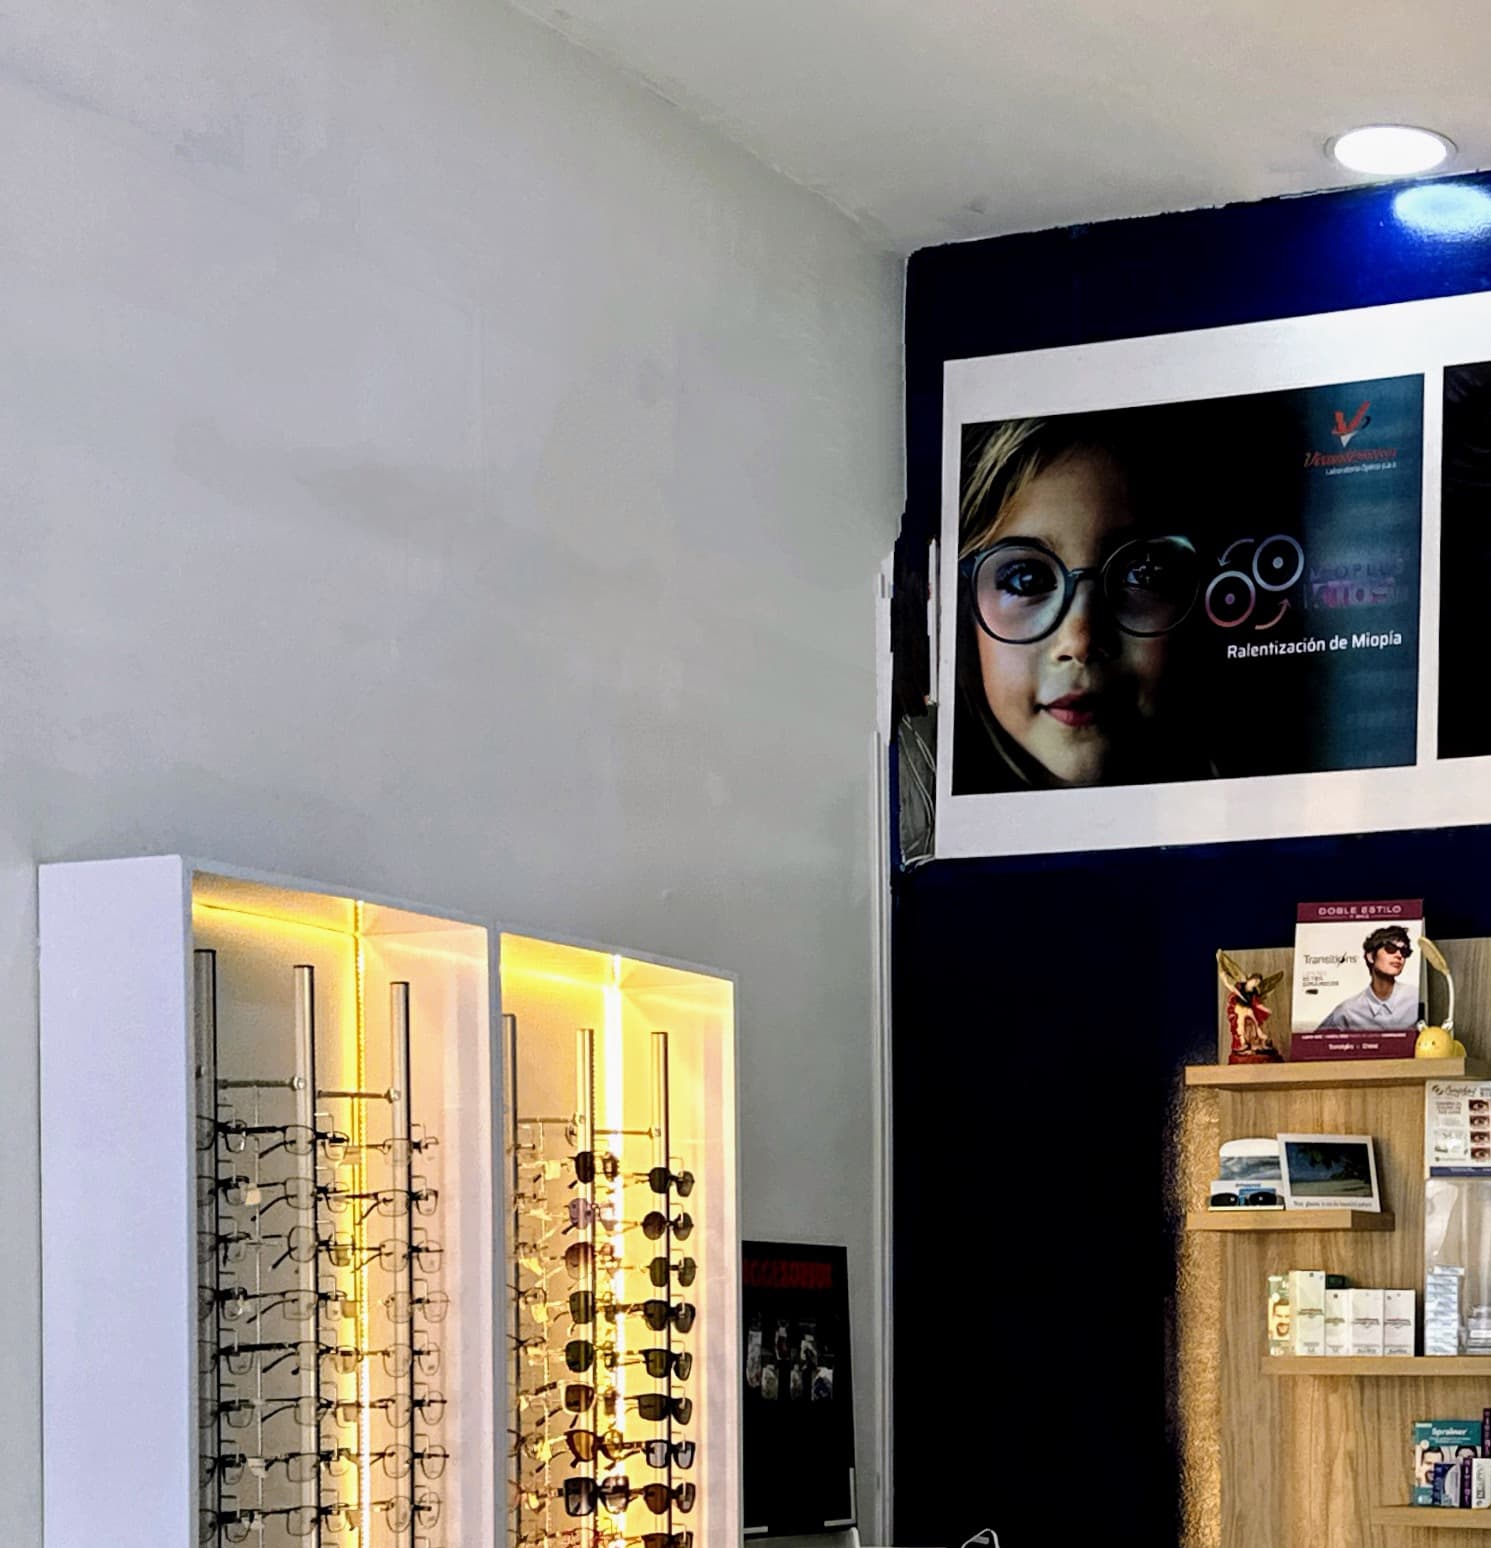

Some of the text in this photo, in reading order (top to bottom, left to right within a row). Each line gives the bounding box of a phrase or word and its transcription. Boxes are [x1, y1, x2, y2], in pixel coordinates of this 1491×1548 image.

[1227, 629, 1403, 659] Ralentización de Miopía
[1318, 905, 1402, 916] DOBLE ESTILO
